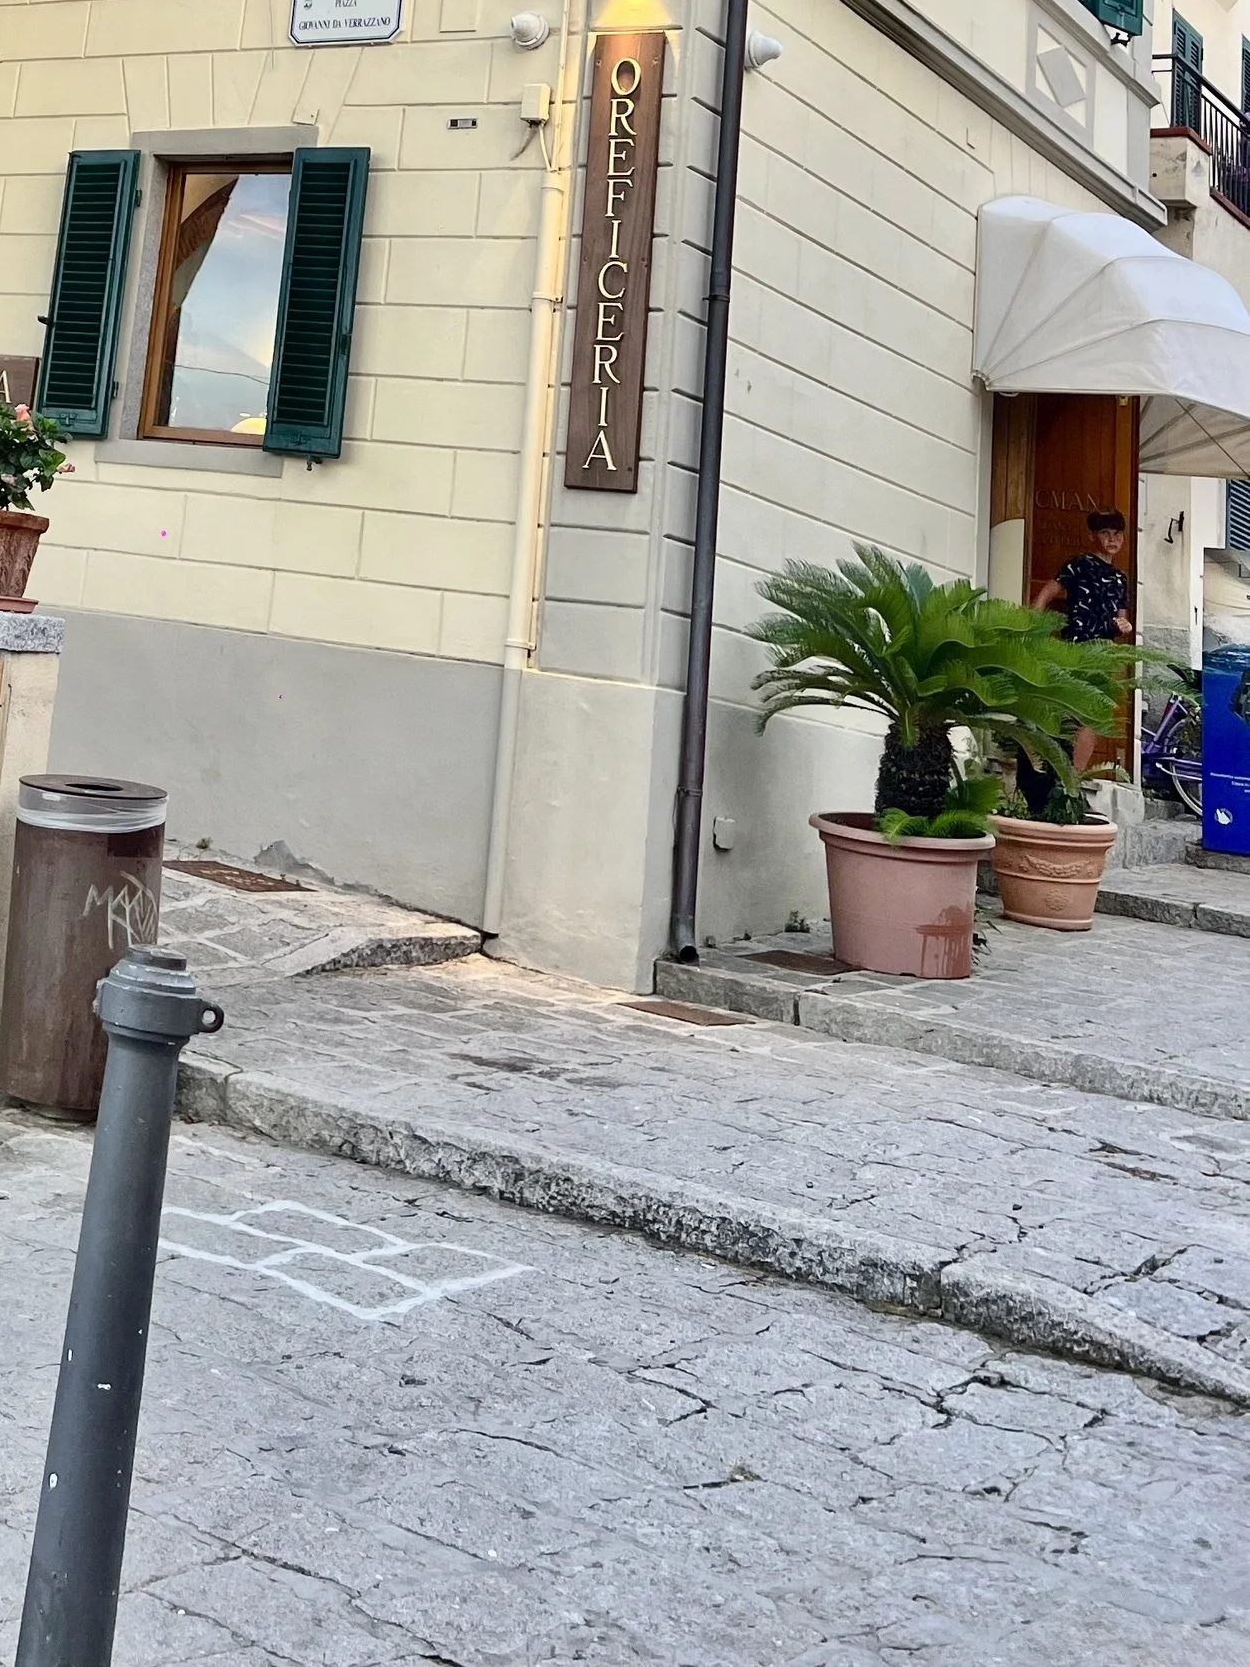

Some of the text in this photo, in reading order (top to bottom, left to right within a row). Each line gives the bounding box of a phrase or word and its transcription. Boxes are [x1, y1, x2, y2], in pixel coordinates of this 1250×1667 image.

[299, 17, 391, 31] GIOVANNI DA VERRAZZANO
[582, 57, 642, 471] OREFICERIA
